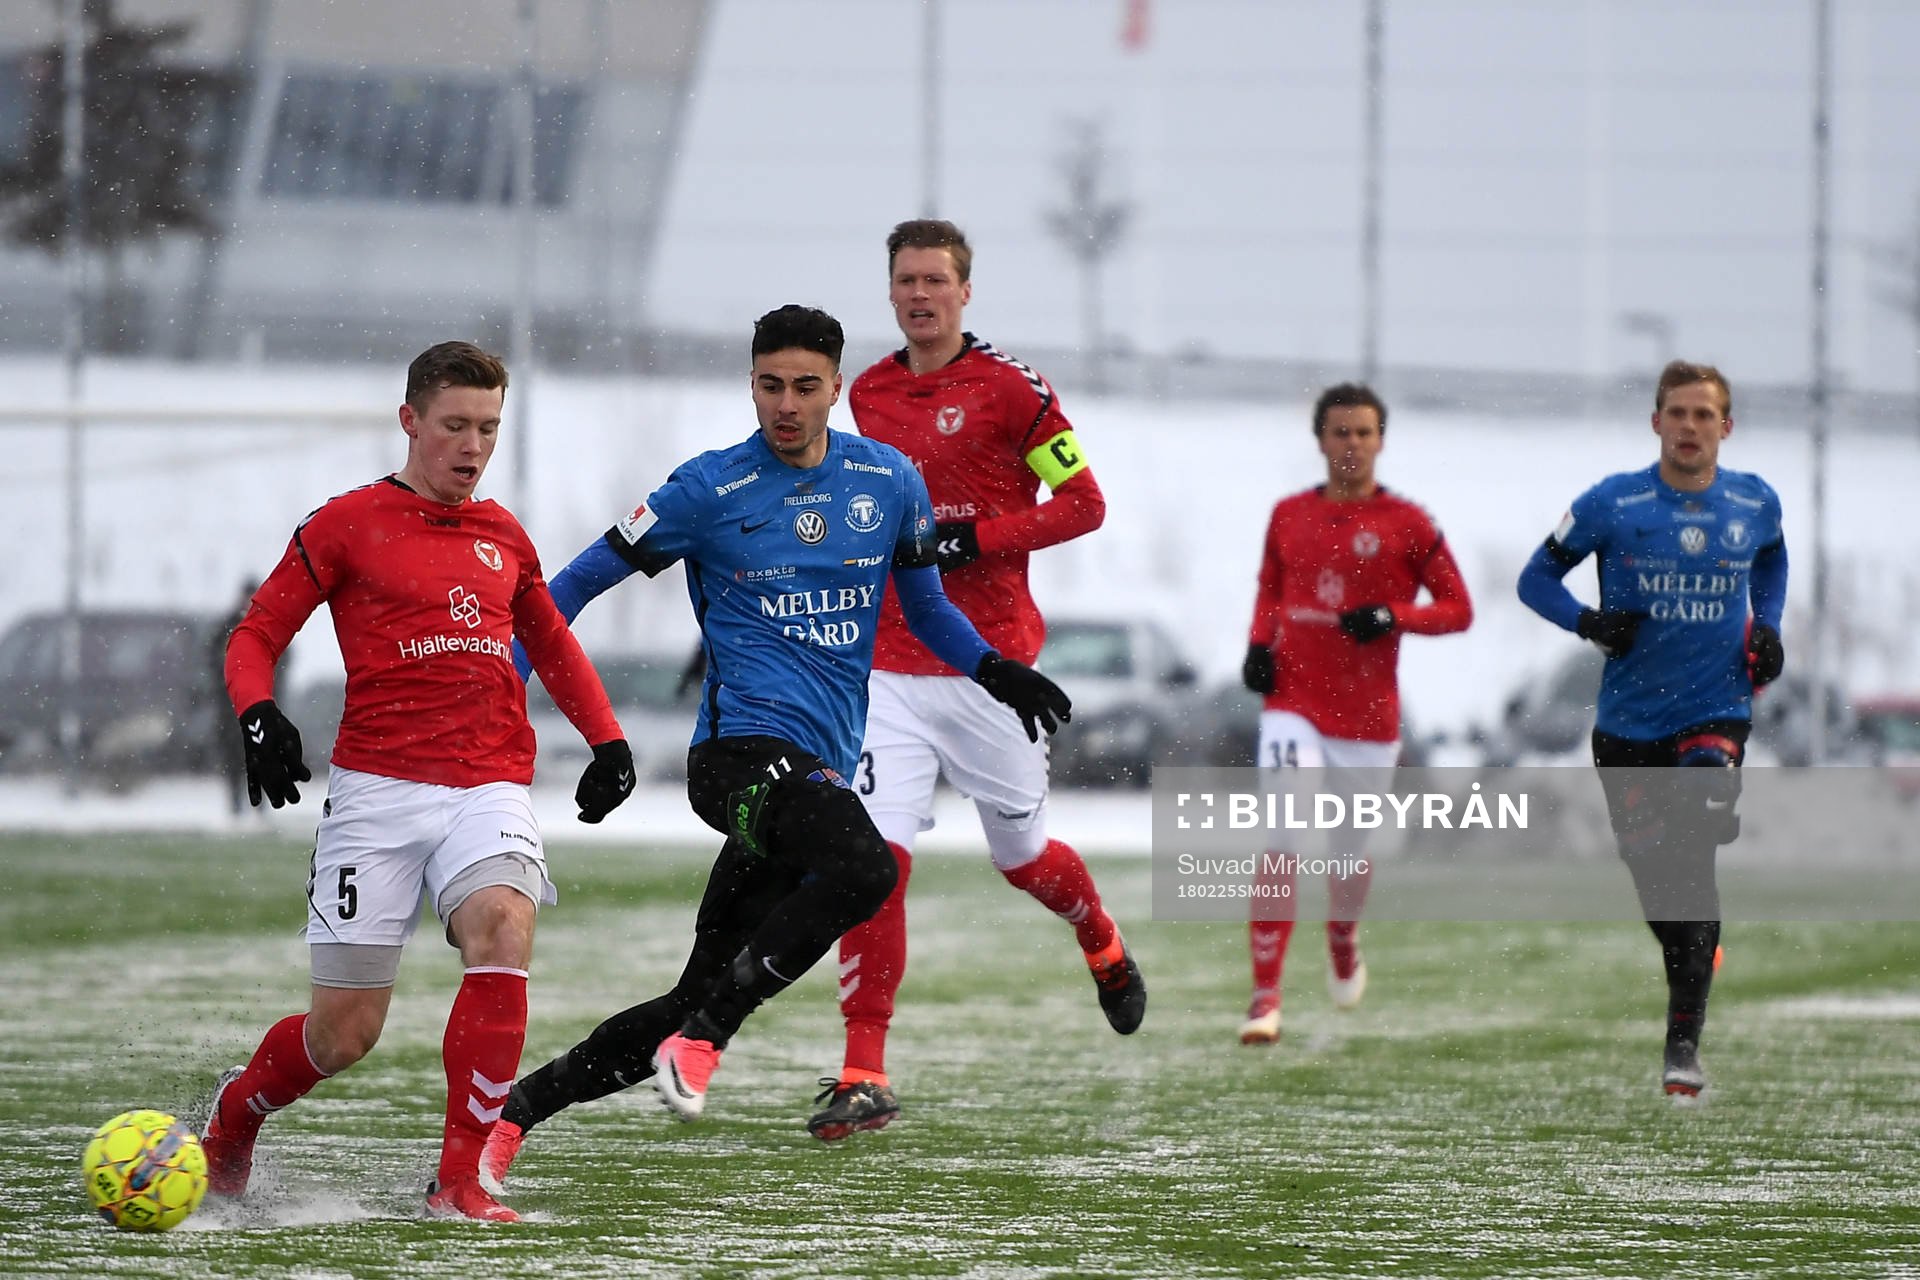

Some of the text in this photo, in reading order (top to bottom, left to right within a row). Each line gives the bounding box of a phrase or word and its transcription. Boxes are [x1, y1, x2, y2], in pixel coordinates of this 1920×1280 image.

[1050, 437, 1079, 468] C
[783, 493, 832, 507] TRELLEBORG
[747, 566, 796, 578] exakta
[1637, 573, 1740, 594] MELLBY
[759, 584, 876, 618] MELLBY
[1650, 598, 1725, 622] GÅRD
[783, 617, 860, 647] GÅRD
[766, 756, 792, 781] 11
[337, 866, 358, 920] 5
